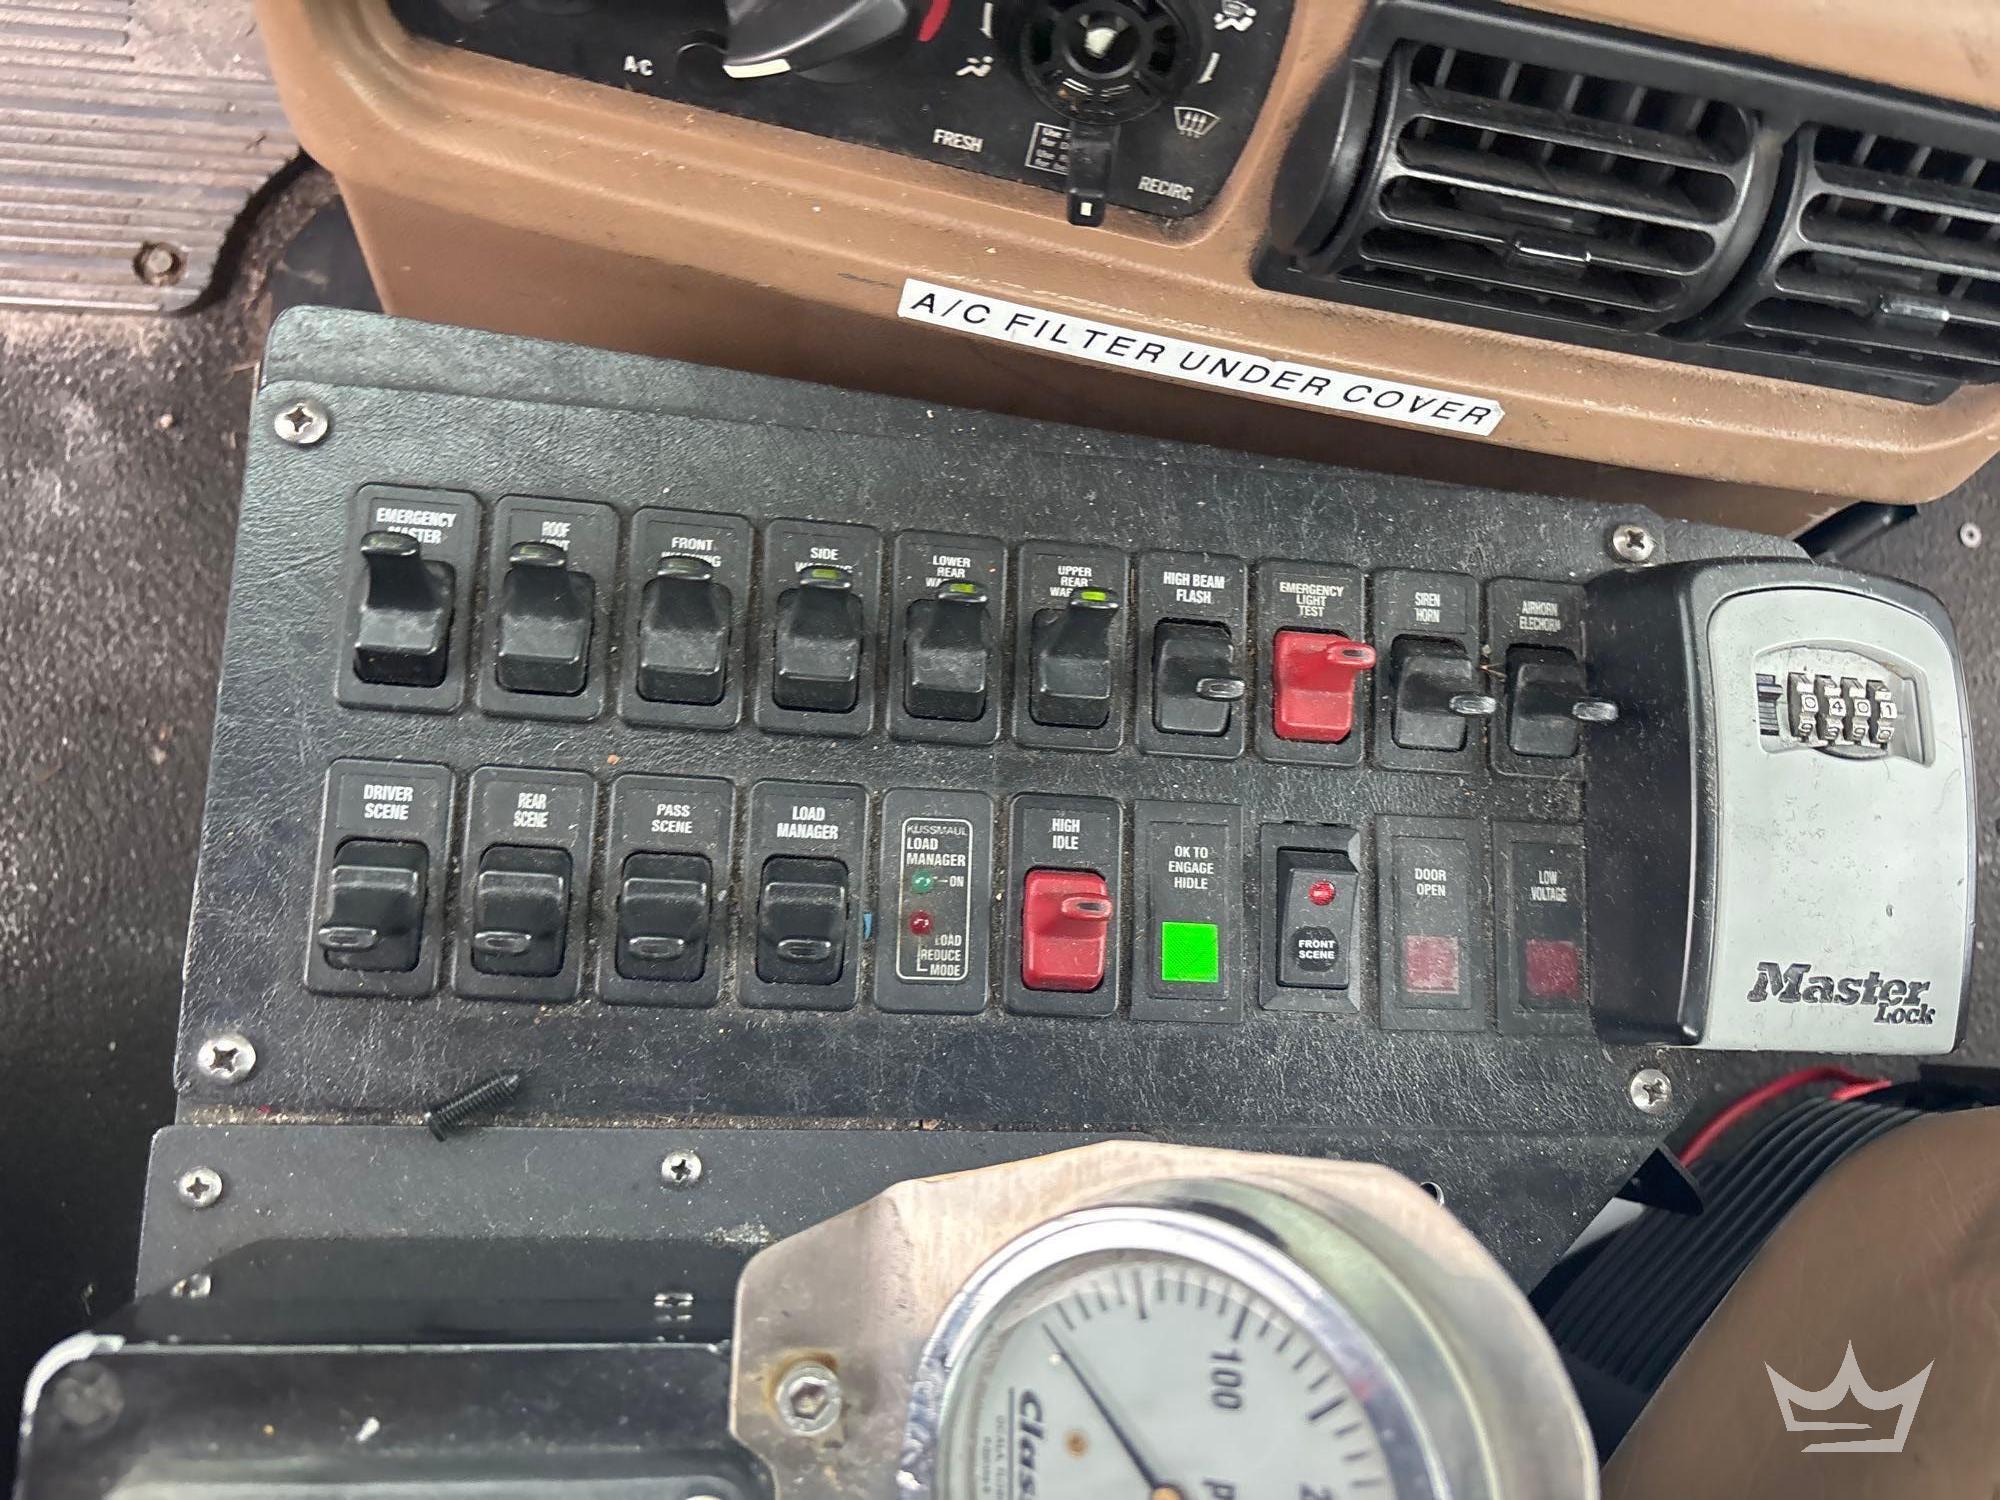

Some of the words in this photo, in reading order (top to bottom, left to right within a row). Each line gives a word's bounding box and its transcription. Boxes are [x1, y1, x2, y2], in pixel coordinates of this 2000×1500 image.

[933, 128, 983, 153] FRESH
[1138, 176, 1194, 201] RECIRC
[910, 292, 991, 324] A/C
[1004, 313, 1166, 363] FILTER
[1180, 351, 1331, 396] UNDER
[1343, 385, 1492, 426] COVER
[376, 507, 457, 528] EMERGENCY
[671, 536, 715, 551] FRONT
[810, 547, 840, 561] SIDE
[932, 555, 971, 568] LOWER
[936, 567, 966, 578] REAR
[1057, 565, 1093, 577] UPPER
[1060, 576, 1089, 588] REAR
[1163, 571, 1190, 586] HIGH
[1192, 573, 1226, 589] BEAM
[1176, 588, 1212, 604] FLASH
[1279, 581, 1345, 597] EMERGENCY
[1296, 594, 1328, 606] LIGHT
[1414, 591, 1441, 607] SIREN
[1299, 605, 1325, 617] TEST
[1415, 607, 1441, 623] HORN
[363, 784, 413, 801] DRIVER
[518, 792, 547, 809] REAR
[364, 802, 409, 821] SCENE
[656, 803, 691, 818] PASS
[792, 805, 825, 821] LOAD
[513, 810, 549, 828] SCENE
[651, 818, 693, 834] SCENE
[1051, 817, 1080, 834] HIGH
[776, 822, 839, 840] MANAGER
[906, 837, 939, 850] LOAD
[1052, 834, 1079, 851] IDLE
[906, 852, 967, 867] MANAGER
[1174, 845, 1192, 859] OK
[1193, 846, 1209, 860] TO
[1168, 860, 1214, 875] ENGAGE
[1414, 867, 1447, 882] DOOR
[949, 875, 965, 888] ON
[1174, 875, 1209, 890] HIDLE
[1538, 870, 1558, 885] LOW
[1416, 883, 1446, 897] OPEN
[1530, 886, 1568, 902] VOLTAGE
[935, 934, 963, 947] LOAD
[1298, 939, 1336, 949] FRONT
[921, 949, 962, 962] REDUCE
[1298, 950, 1336, 960] SCENE
[930, 964, 961, 977] MODE
[1746, 961, 1931, 1007] Master
[1873, 1002, 1936, 1025] Lock
[1209, 1349, 1243, 1411] 100
[1019, 1388, 1045, 1500] Clas
